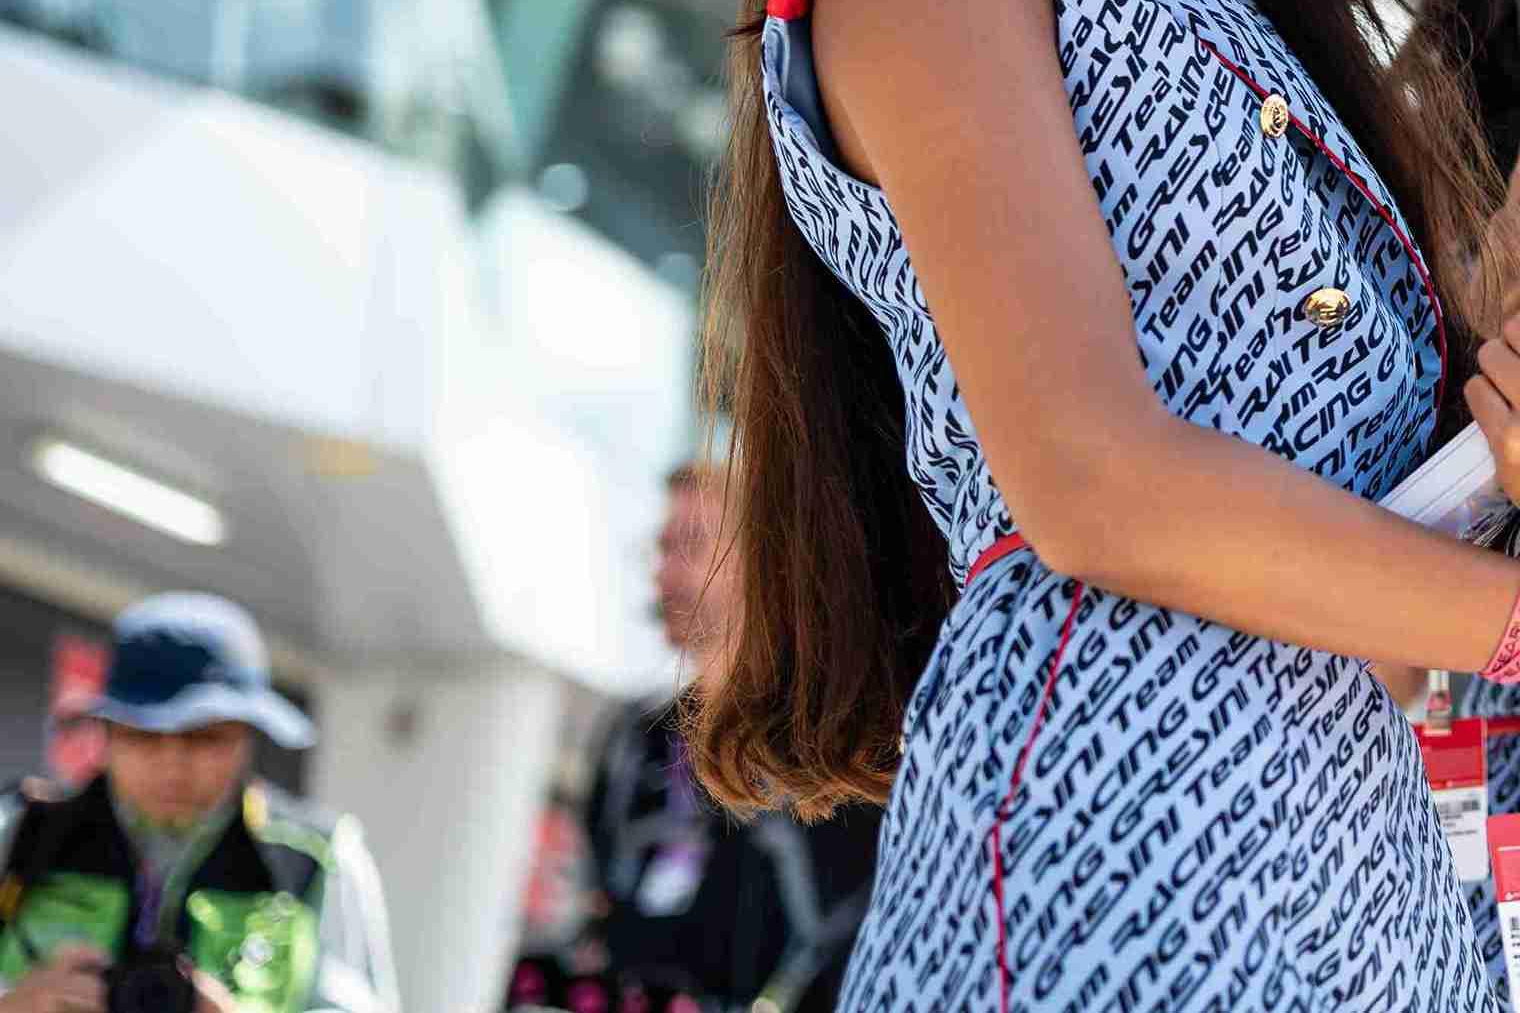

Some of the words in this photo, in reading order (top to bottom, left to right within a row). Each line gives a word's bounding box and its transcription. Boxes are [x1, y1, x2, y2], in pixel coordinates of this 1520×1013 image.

[1142, 240, 1217, 343] Team
[1108, 634, 1200, 732] Team
[1109, 680, 1249, 844] GRESINI
[1032, 698, 1188, 882] RACING
[1033, 805, 1180, 1001] GRESINI
[1184, 714, 1272, 807] Team
[1111, 783, 1256, 953] RACING
